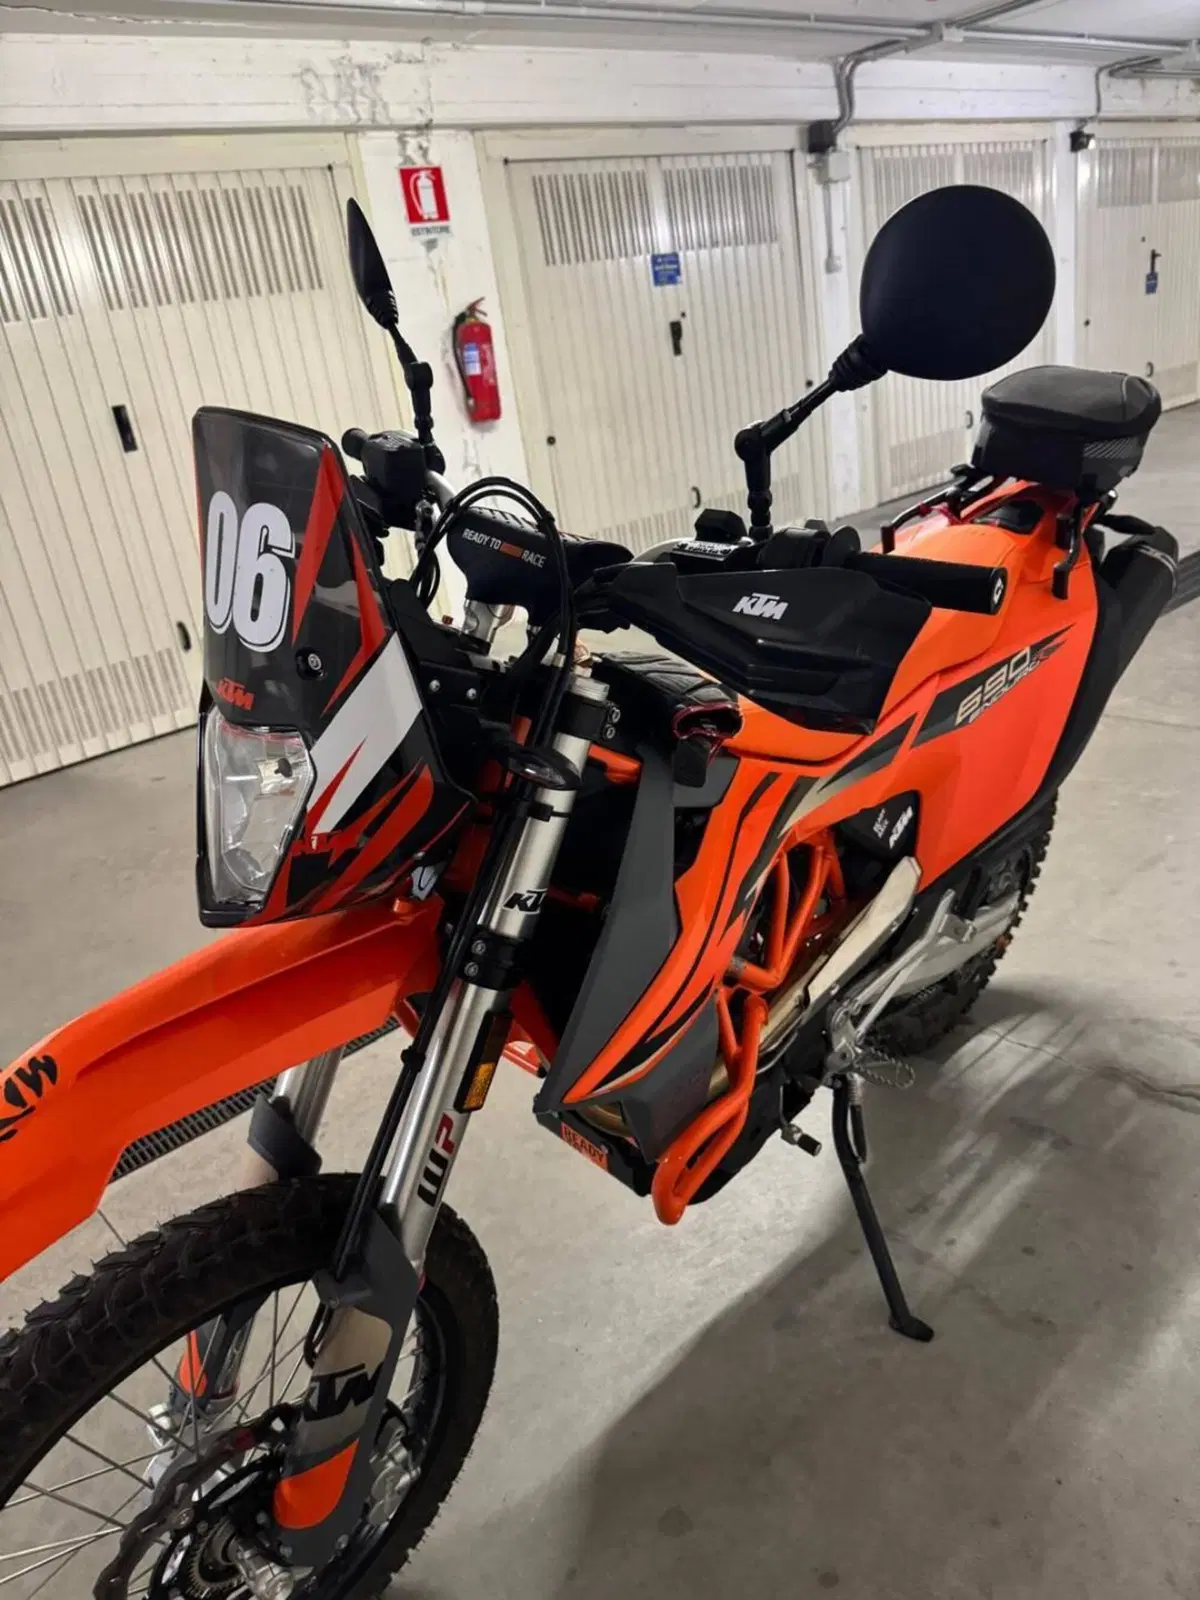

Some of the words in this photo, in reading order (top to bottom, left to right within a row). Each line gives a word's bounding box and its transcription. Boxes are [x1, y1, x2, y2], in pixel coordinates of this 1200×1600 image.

[205, 490, 297, 653] 06
[462, 528, 490, 545] READY
[489, 537, 502, 550] TO
[521, 550, 546, 568] RACE
[732, 592, 789, 620] KTM
[954, 645, 1031, 727] 690
